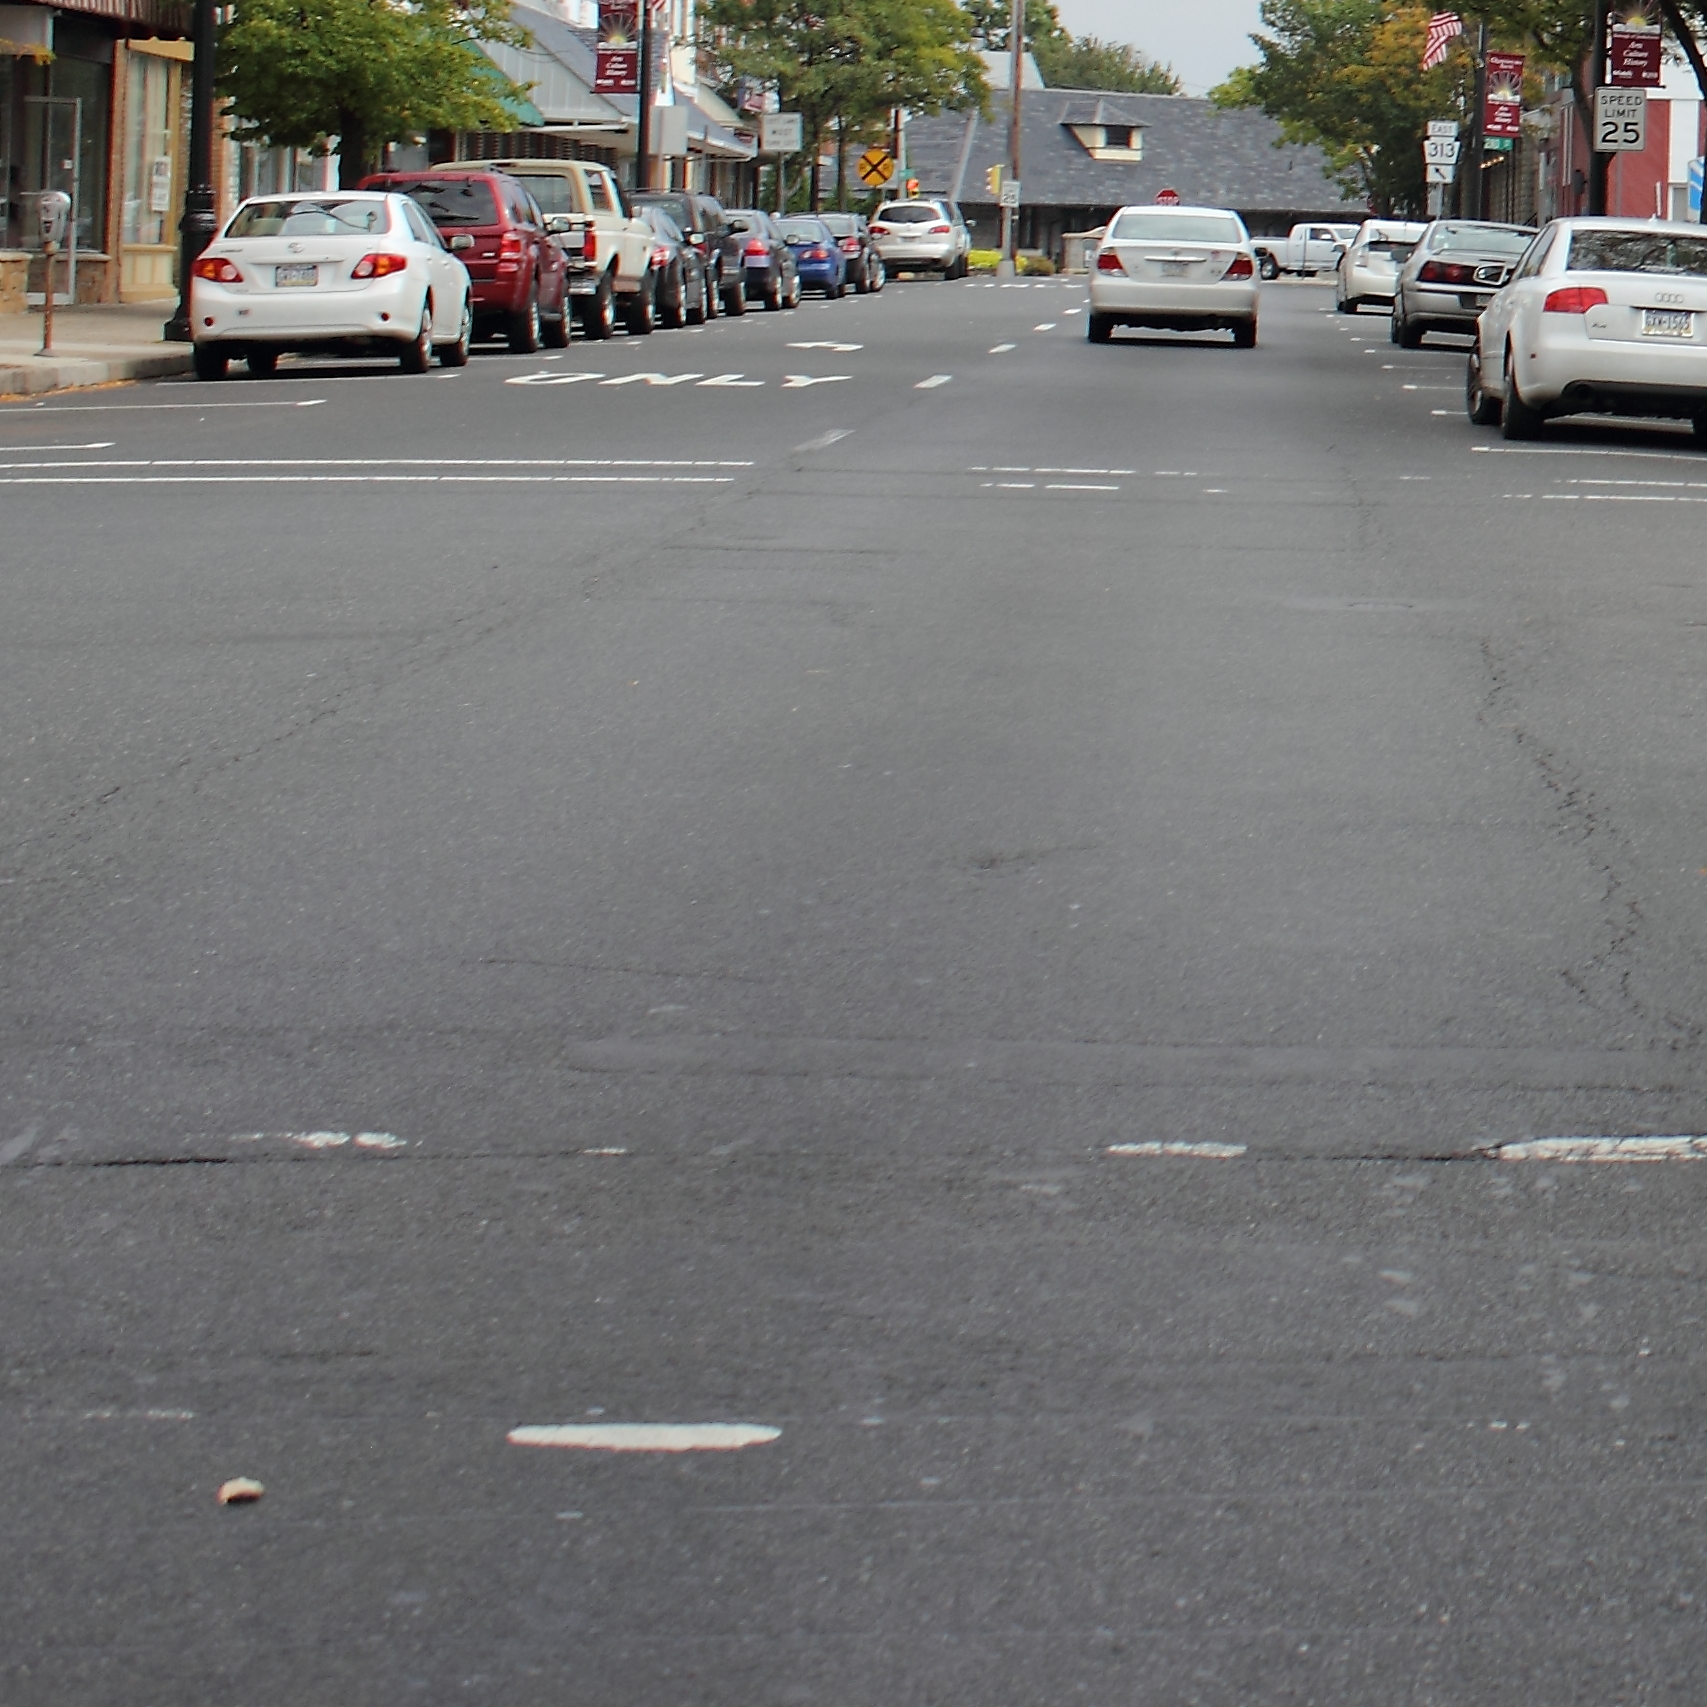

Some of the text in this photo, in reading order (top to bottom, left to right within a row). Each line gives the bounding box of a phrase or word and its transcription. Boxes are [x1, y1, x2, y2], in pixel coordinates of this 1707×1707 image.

[1601, 95, 1643, 106] SPEED
[1604, 108, 1638, 118] LIMIT
[1601, 121, 1640, 144] 25
[1429, 142, 1455, 158] 313
[505, 370, 854, 388] ONLY
